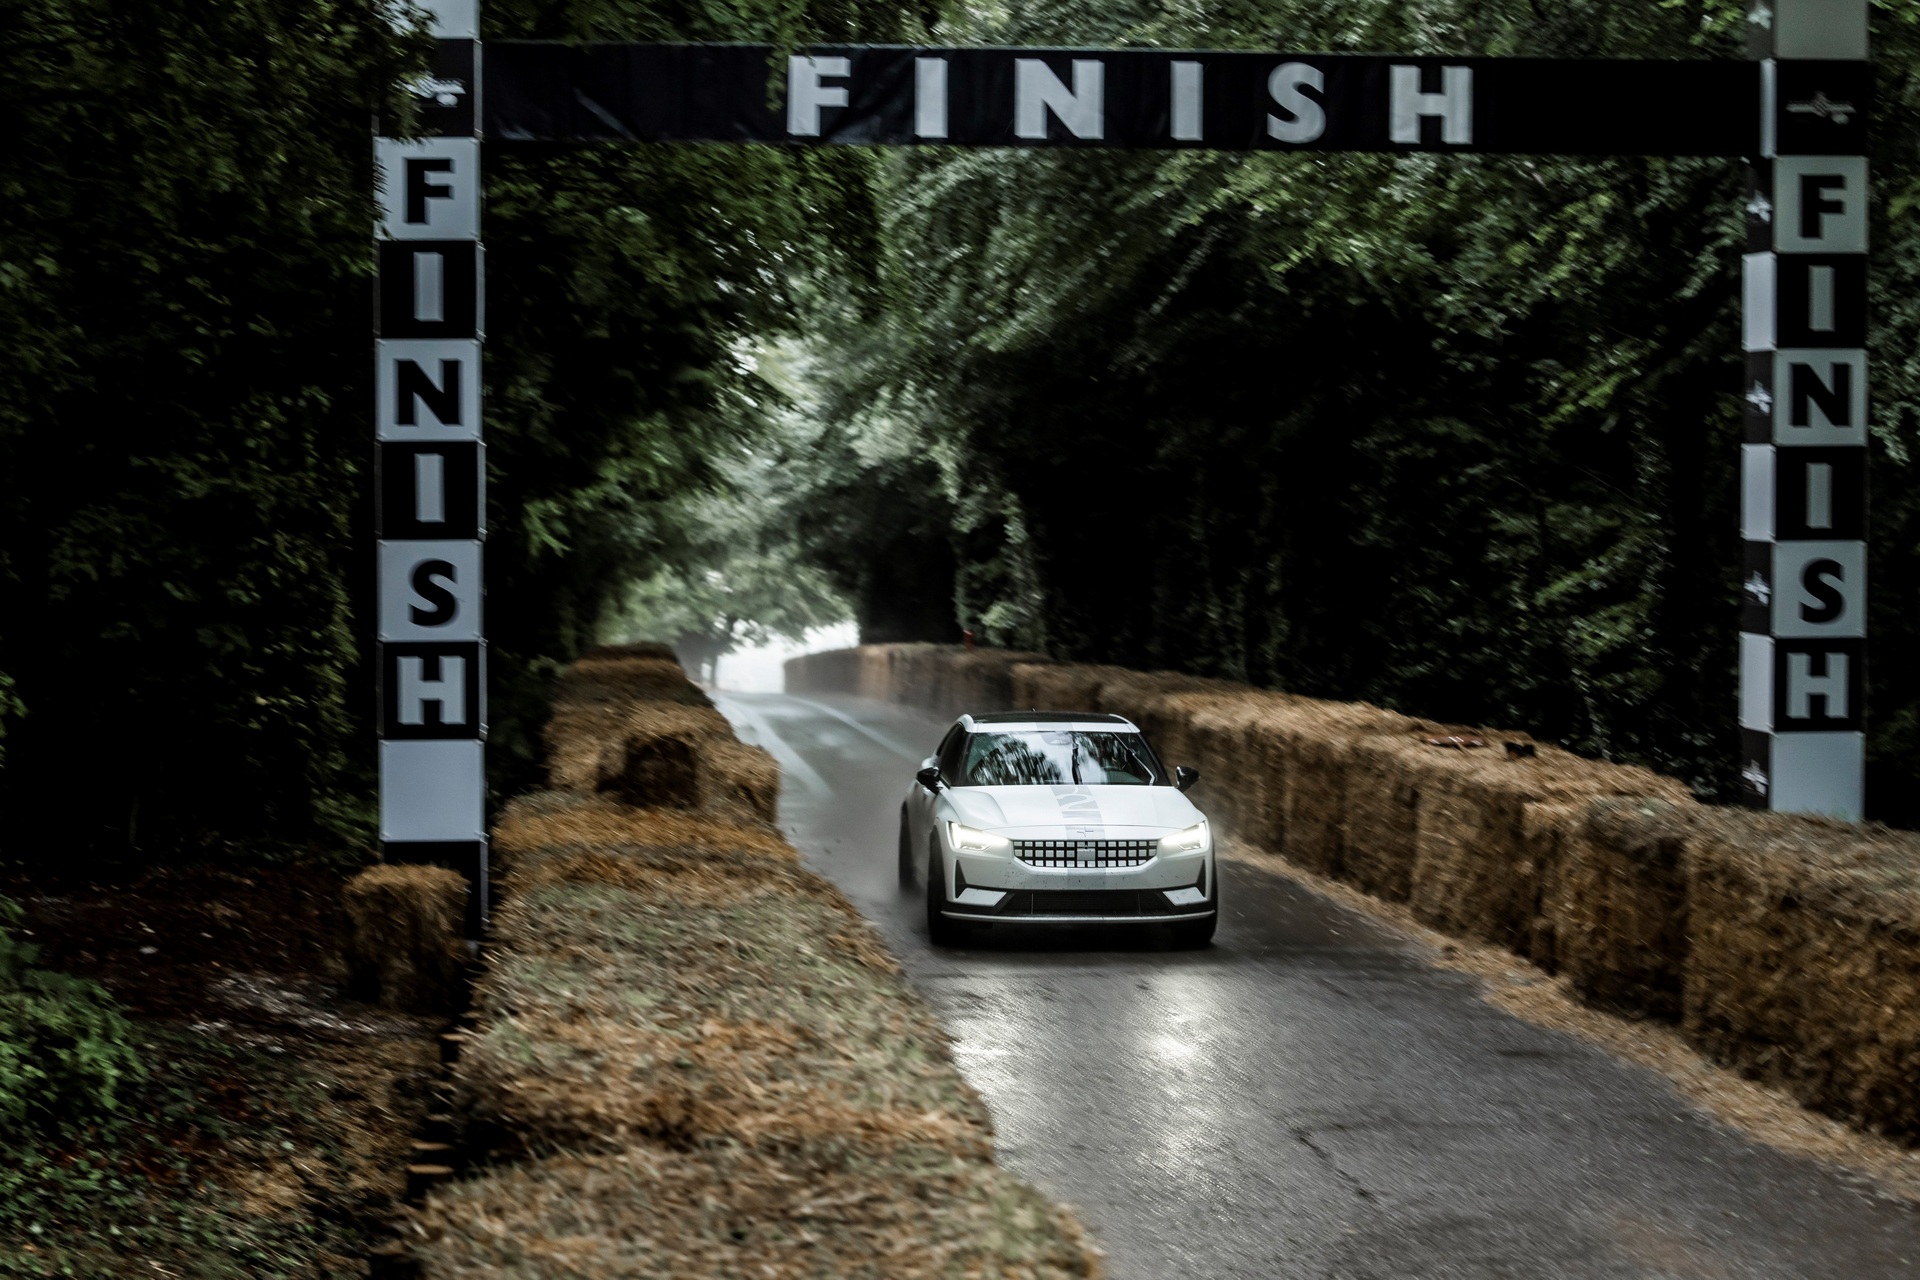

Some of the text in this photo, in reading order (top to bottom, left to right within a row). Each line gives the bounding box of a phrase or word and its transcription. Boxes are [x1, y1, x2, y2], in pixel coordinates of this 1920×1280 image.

[786, 55, 1473, 143] FINISH
[394, 157, 466, 725] FINISH
[1785, 173, 1853, 720] FINISH
